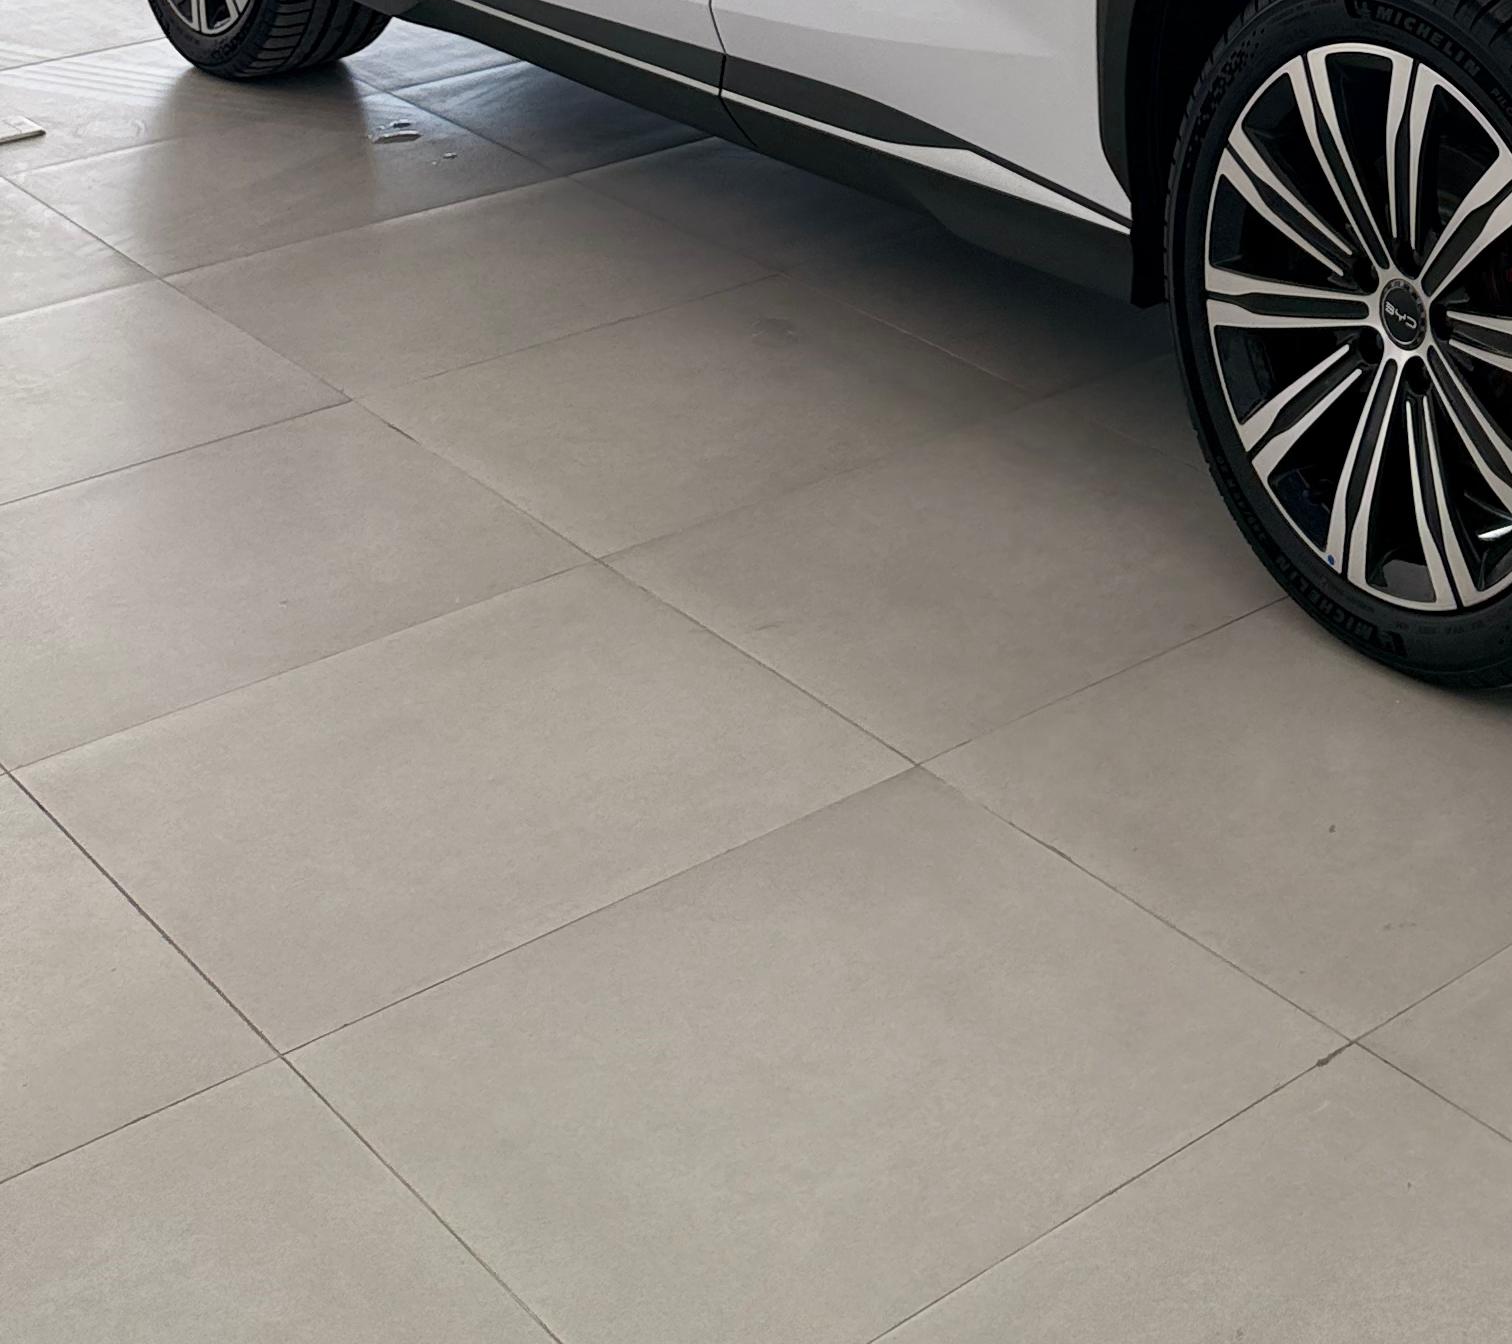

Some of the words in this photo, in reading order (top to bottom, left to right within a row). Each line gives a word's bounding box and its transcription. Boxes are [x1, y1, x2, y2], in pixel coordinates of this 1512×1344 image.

[1375, 5, 1481, 77] MICHELIN
[1385, 301, 1417, 329] BYD
[1274, 555, 1376, 642] MICHELIN
